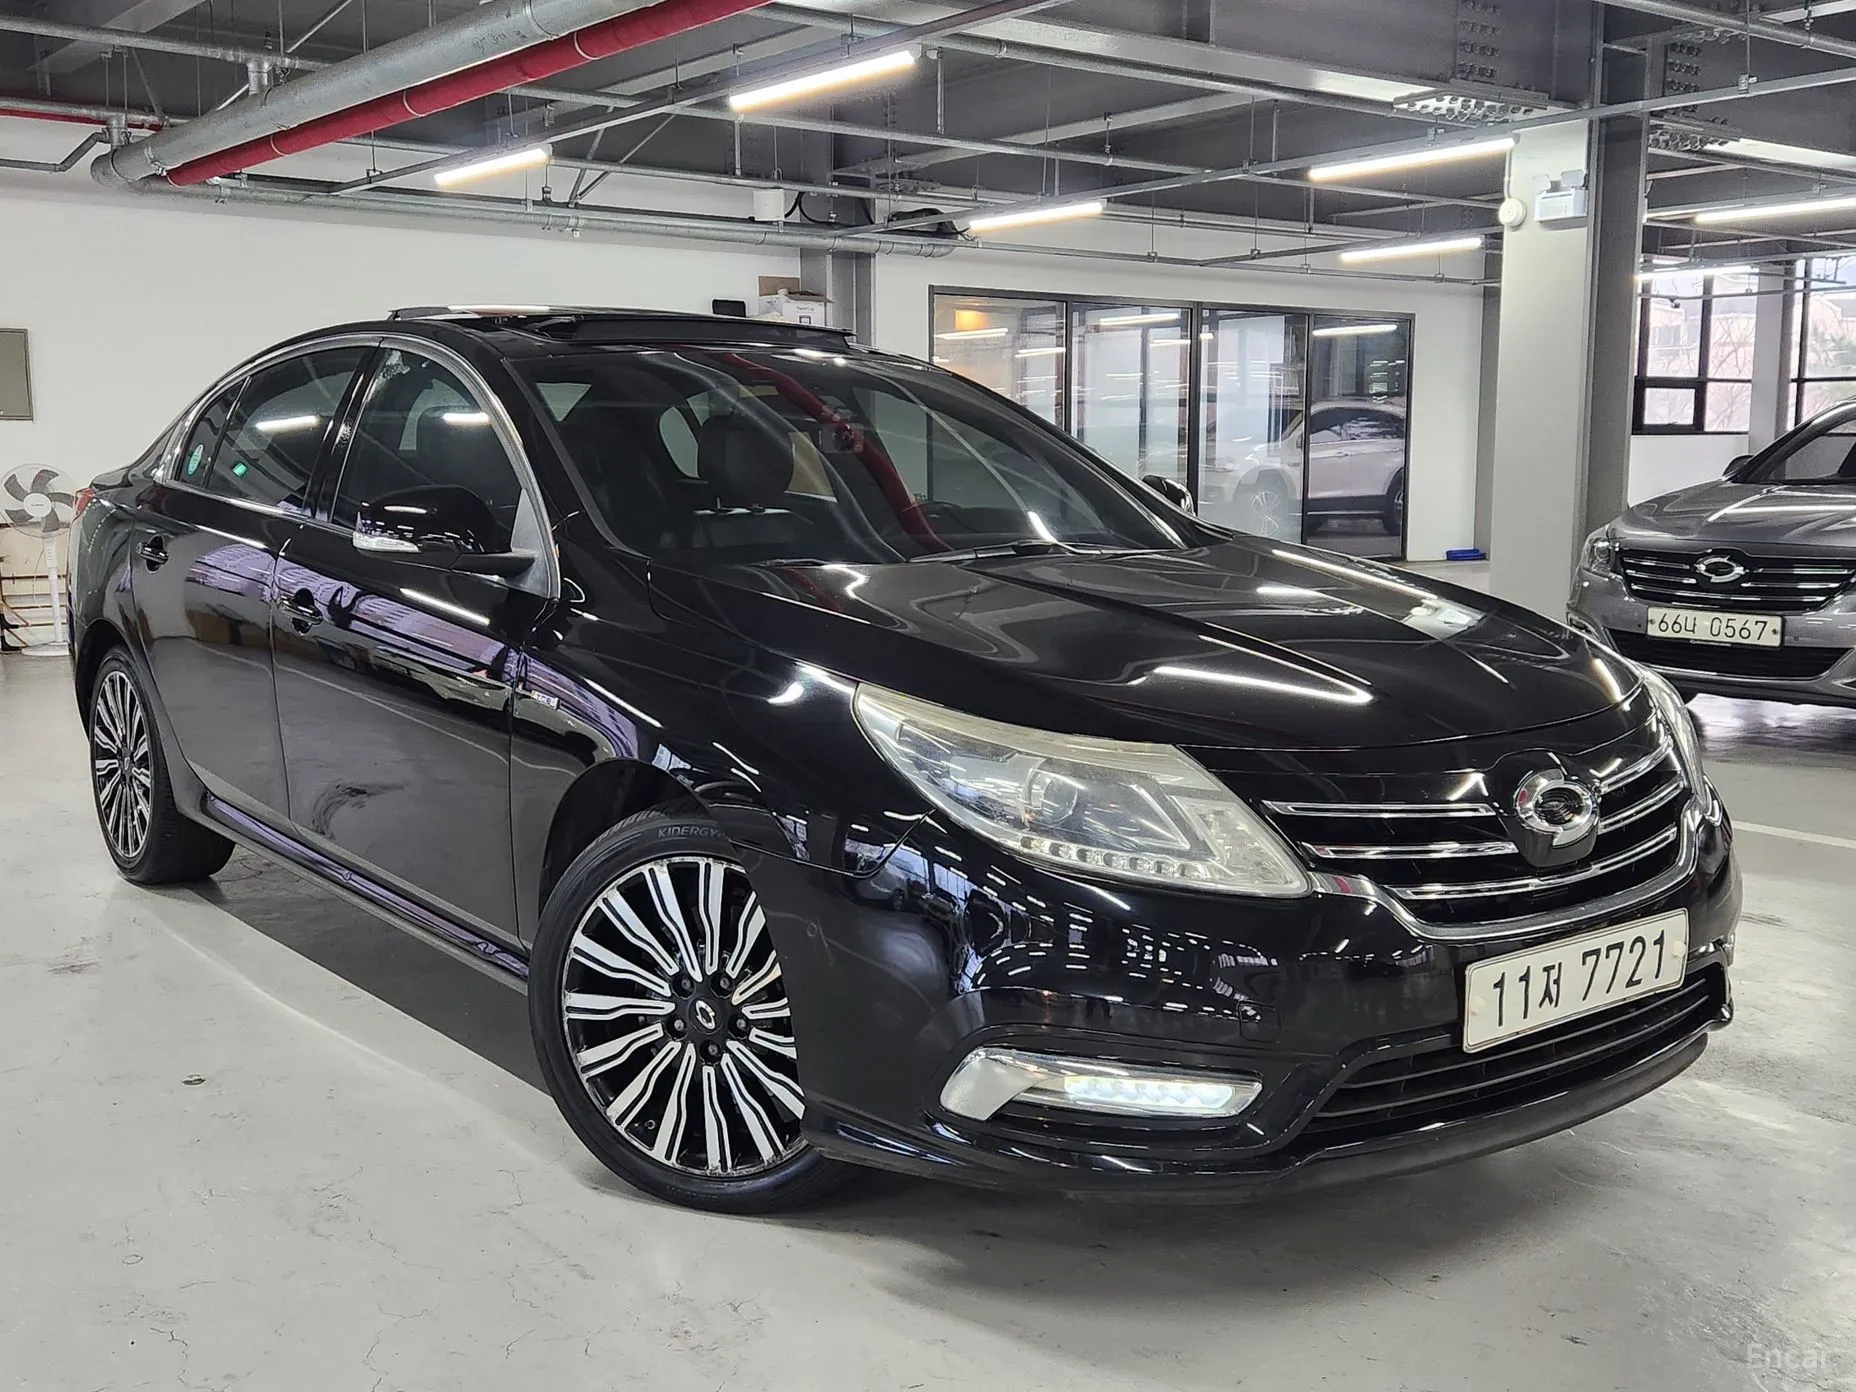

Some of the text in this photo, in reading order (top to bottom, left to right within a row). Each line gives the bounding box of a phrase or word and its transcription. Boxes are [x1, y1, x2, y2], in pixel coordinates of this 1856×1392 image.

[1658, 613, 1768, 641] 66나 0567
[658, 826, 719, 838] KINERGY
[1493, 929, 1665, 1027] 11저 7721
